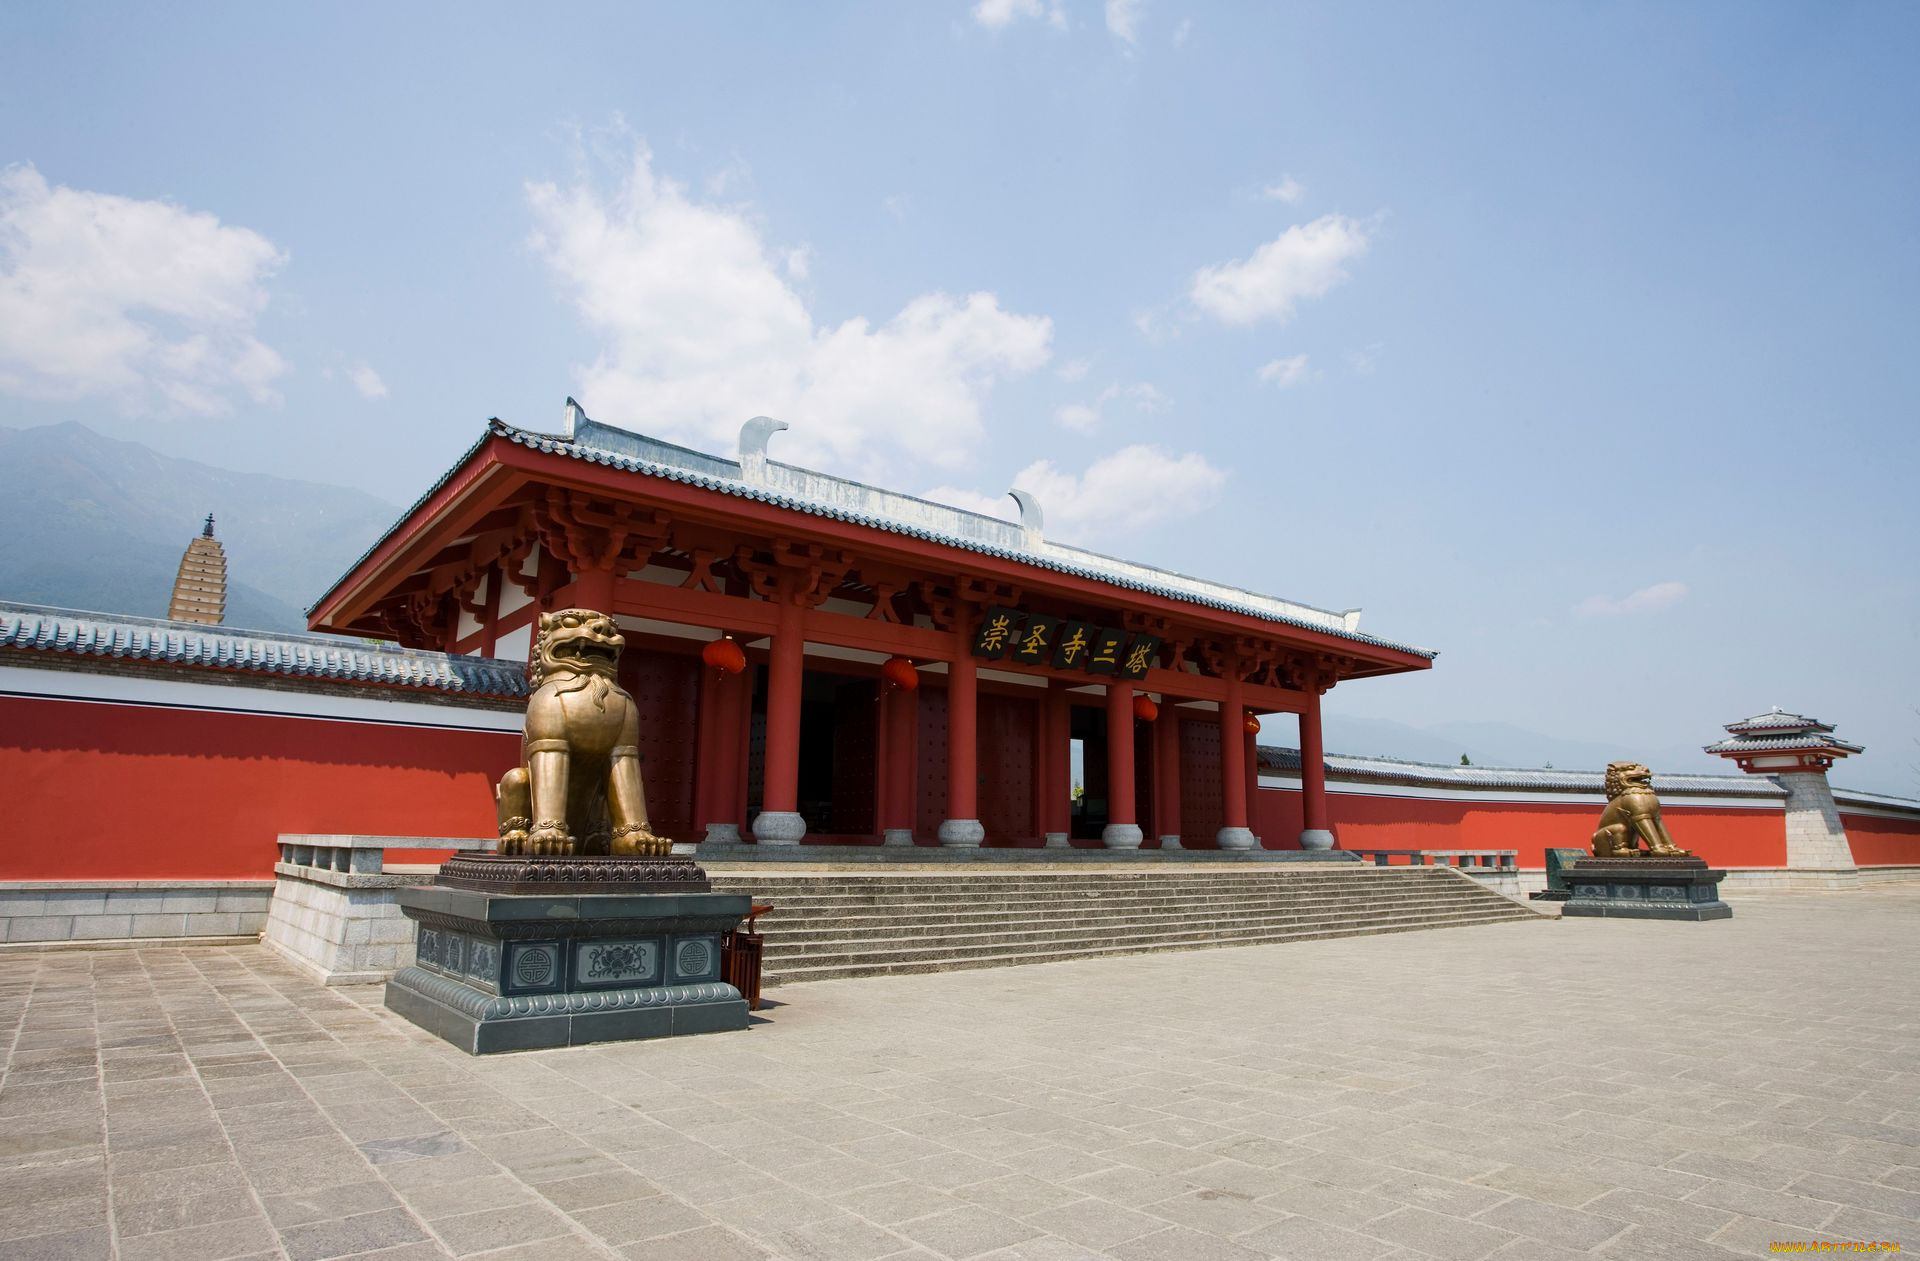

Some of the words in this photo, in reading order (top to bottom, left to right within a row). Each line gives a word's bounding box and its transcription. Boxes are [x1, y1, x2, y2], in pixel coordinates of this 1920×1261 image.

[980, 614, 1152, 673] 崇圣寺三塔
